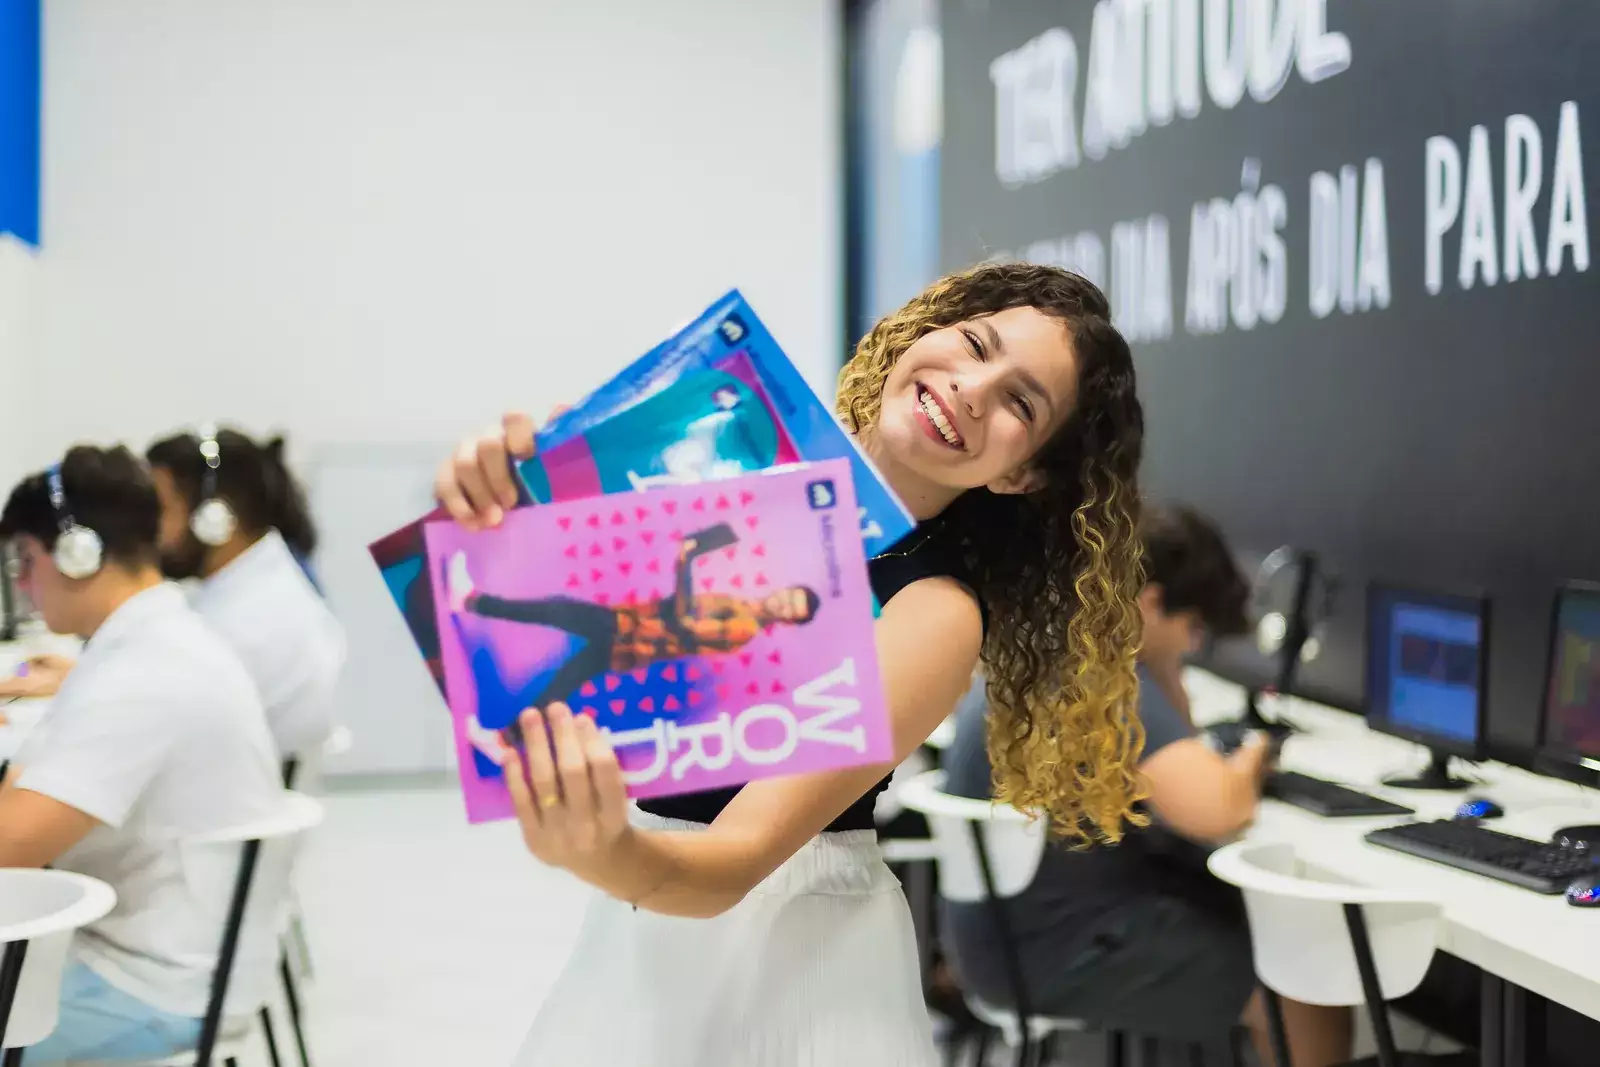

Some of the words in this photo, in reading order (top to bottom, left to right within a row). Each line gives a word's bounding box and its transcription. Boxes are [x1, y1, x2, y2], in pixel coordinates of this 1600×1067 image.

[1186, 157, 1287, 334] APÓS
[1309, 157, 1390, 317] DIA
[1425, 100, 1589, 296] PARA
[602, 657, 866, 784] WORD
